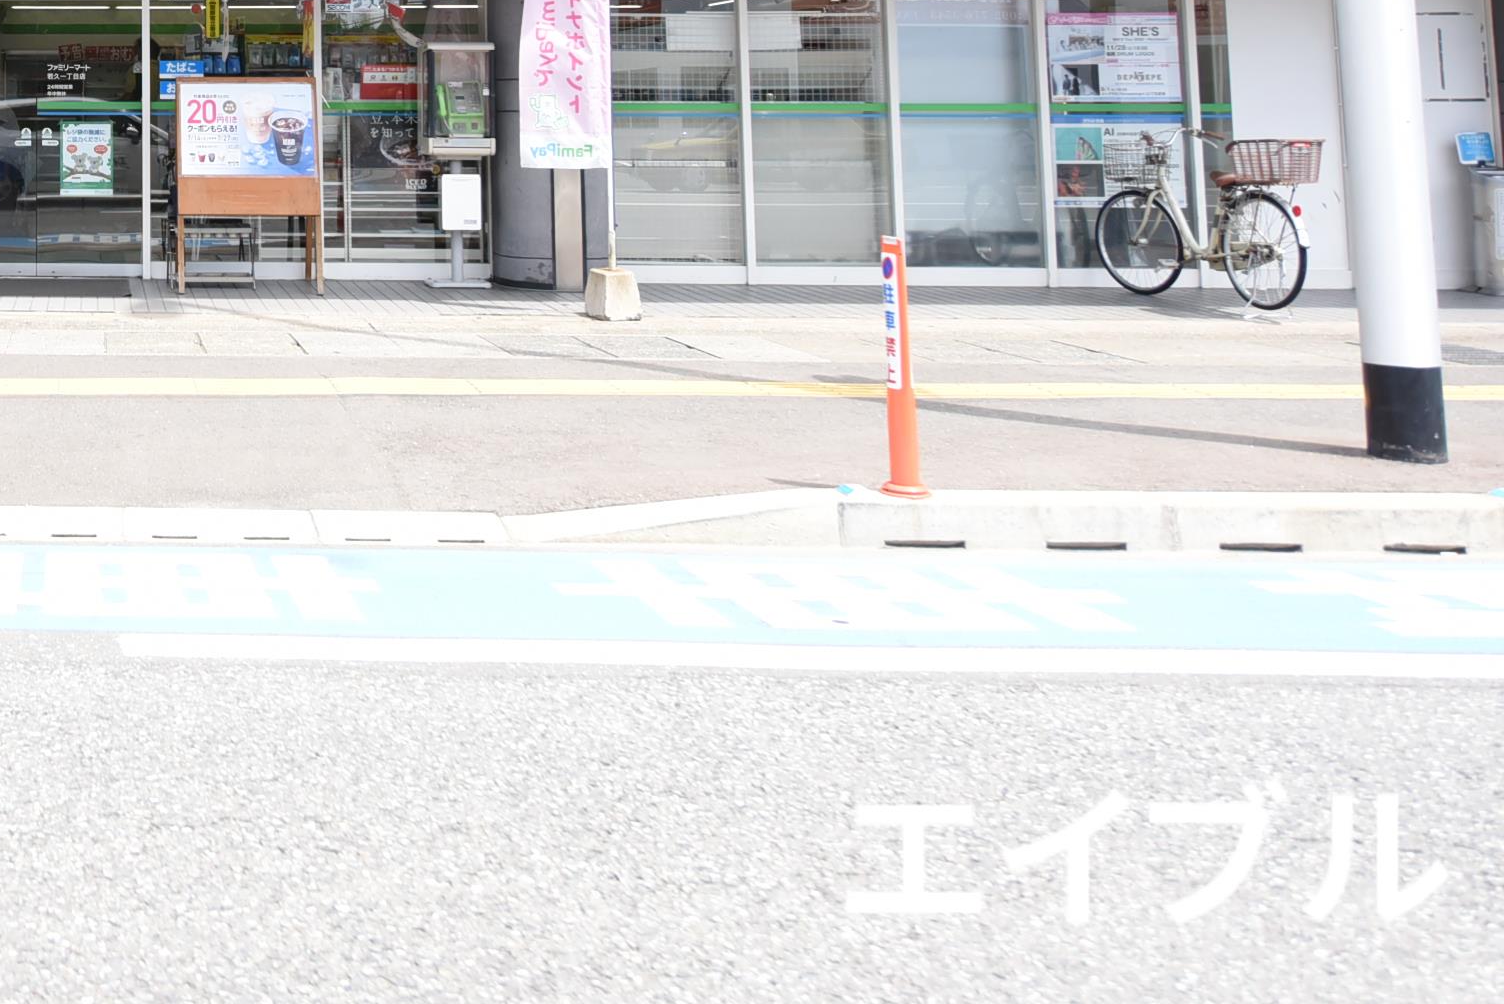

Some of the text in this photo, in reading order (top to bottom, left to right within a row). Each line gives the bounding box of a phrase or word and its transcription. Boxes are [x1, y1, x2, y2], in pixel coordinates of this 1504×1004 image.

[1122, 26, 1160, 37] SHE'S
[47, 63, 91, 72] ファミリーマート
[166, 62, 197, 73] たばこ
